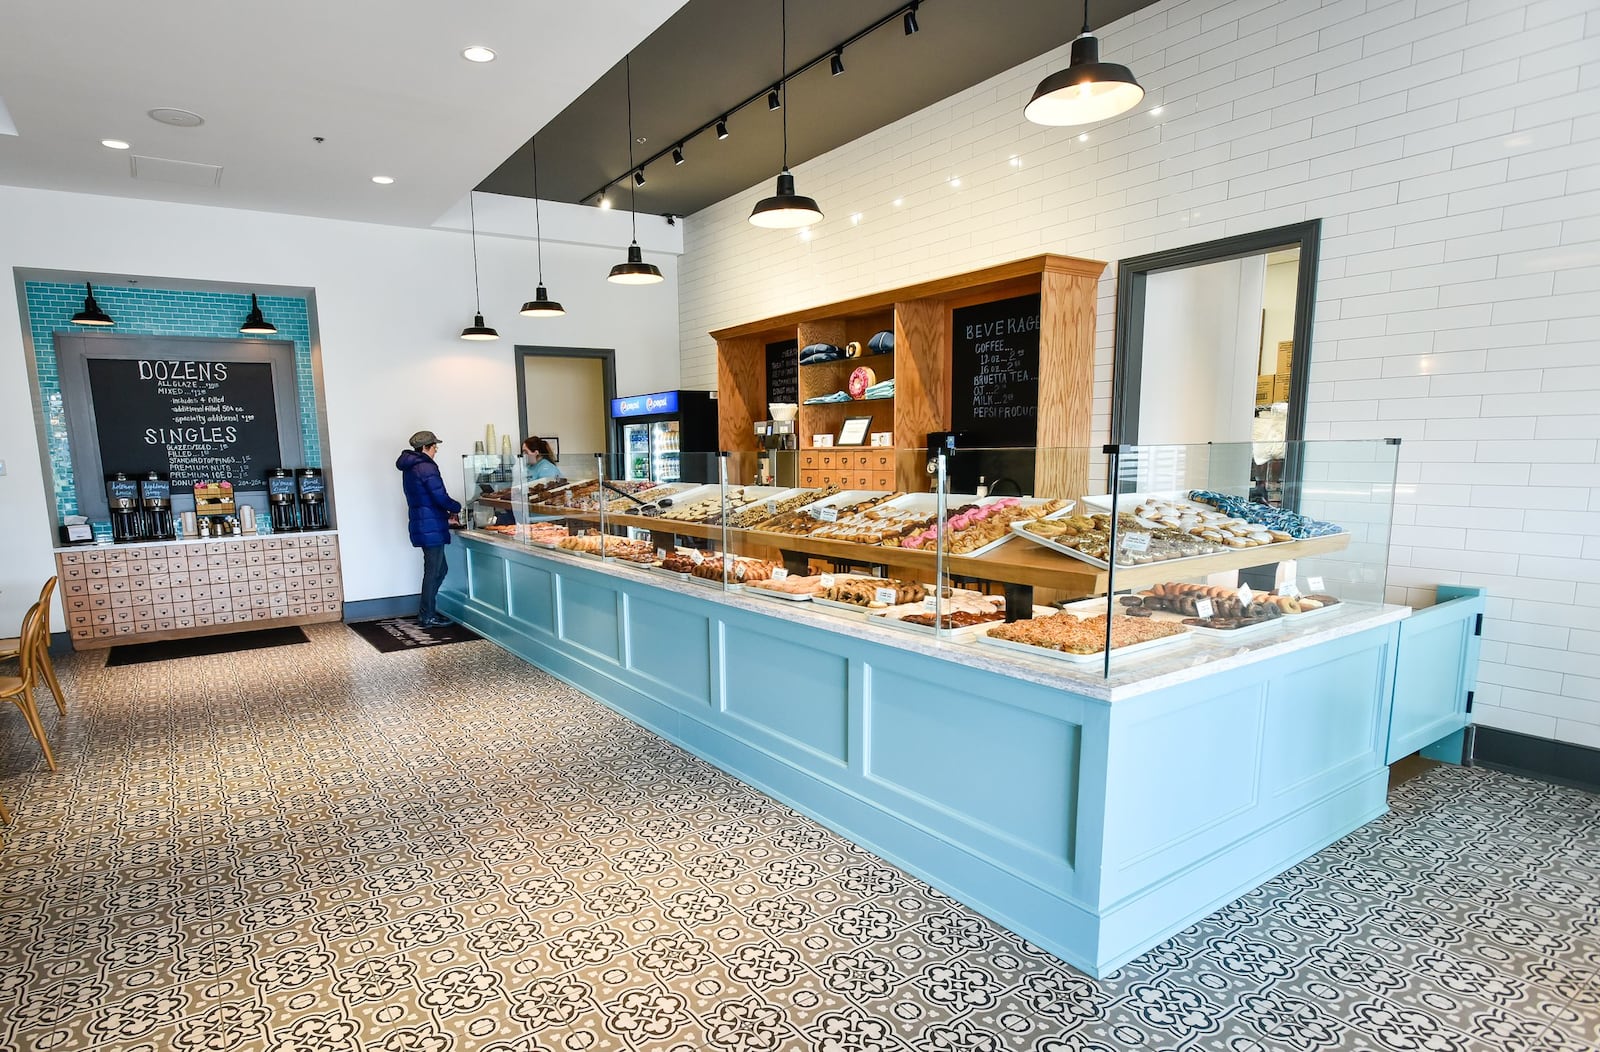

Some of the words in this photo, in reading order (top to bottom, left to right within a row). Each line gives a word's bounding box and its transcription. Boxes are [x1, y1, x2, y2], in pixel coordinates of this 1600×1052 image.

[138, 360, 228, 381] DOZENS
[144, 426, 237, 444] SINGLES
[169, 464, 209, 472] PREMIUM
[169, 471, 209, 479] PREMIUM
